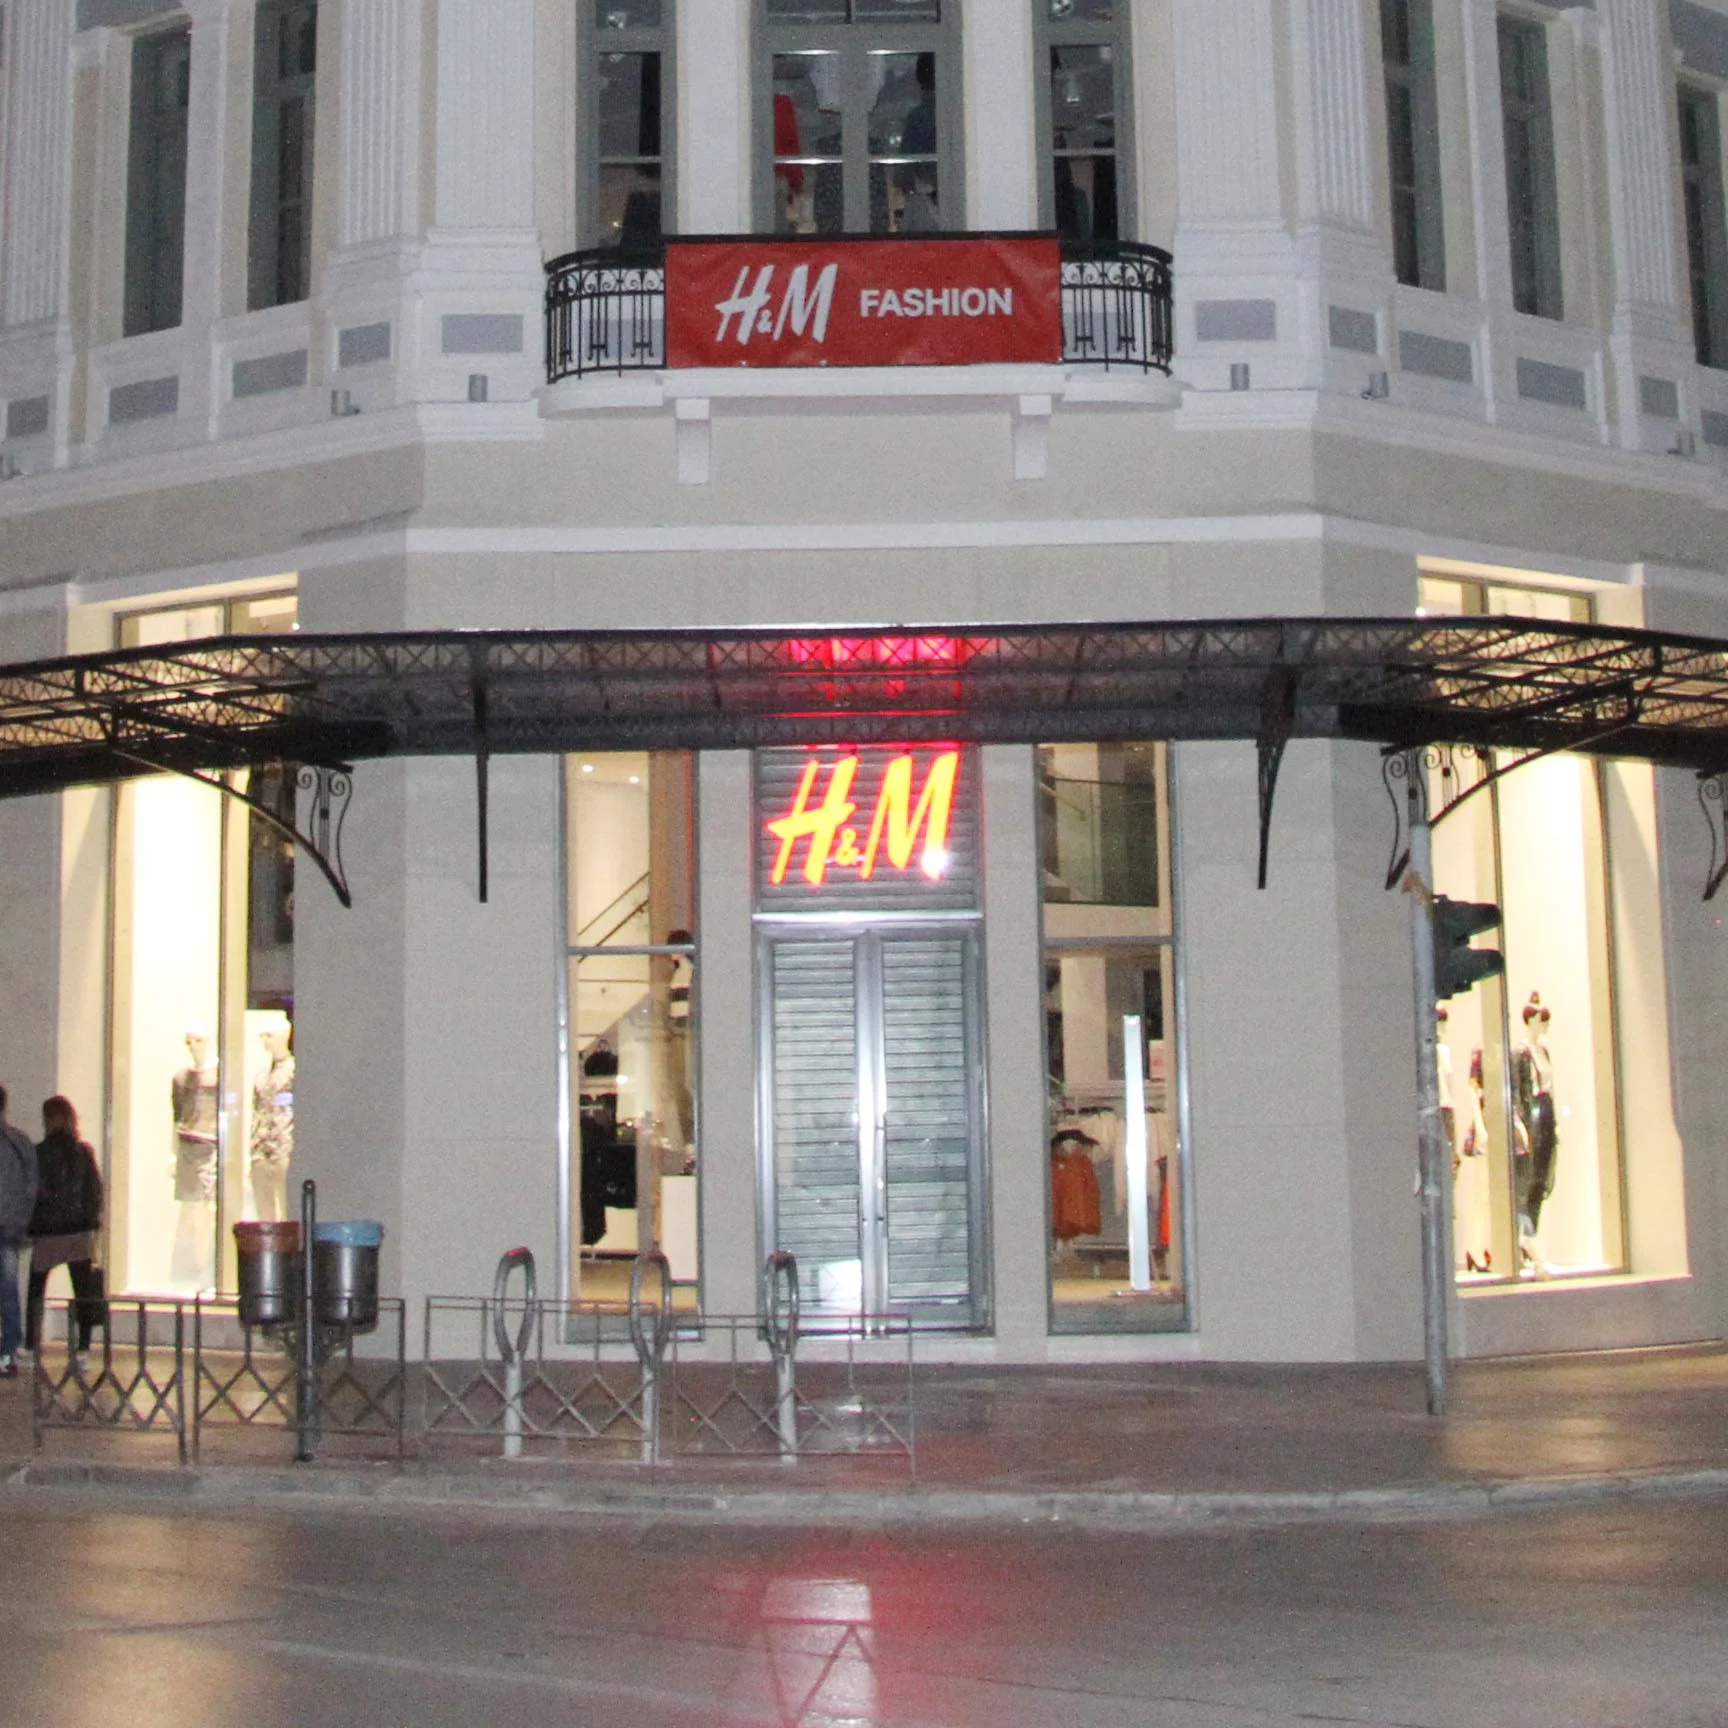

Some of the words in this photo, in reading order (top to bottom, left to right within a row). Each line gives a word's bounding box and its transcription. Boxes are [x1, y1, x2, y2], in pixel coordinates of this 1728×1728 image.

[715, 264, 838, 345] H&M
[860, 288, 1013, 317] FASHION
[767, 751, 961, 885] H&M
